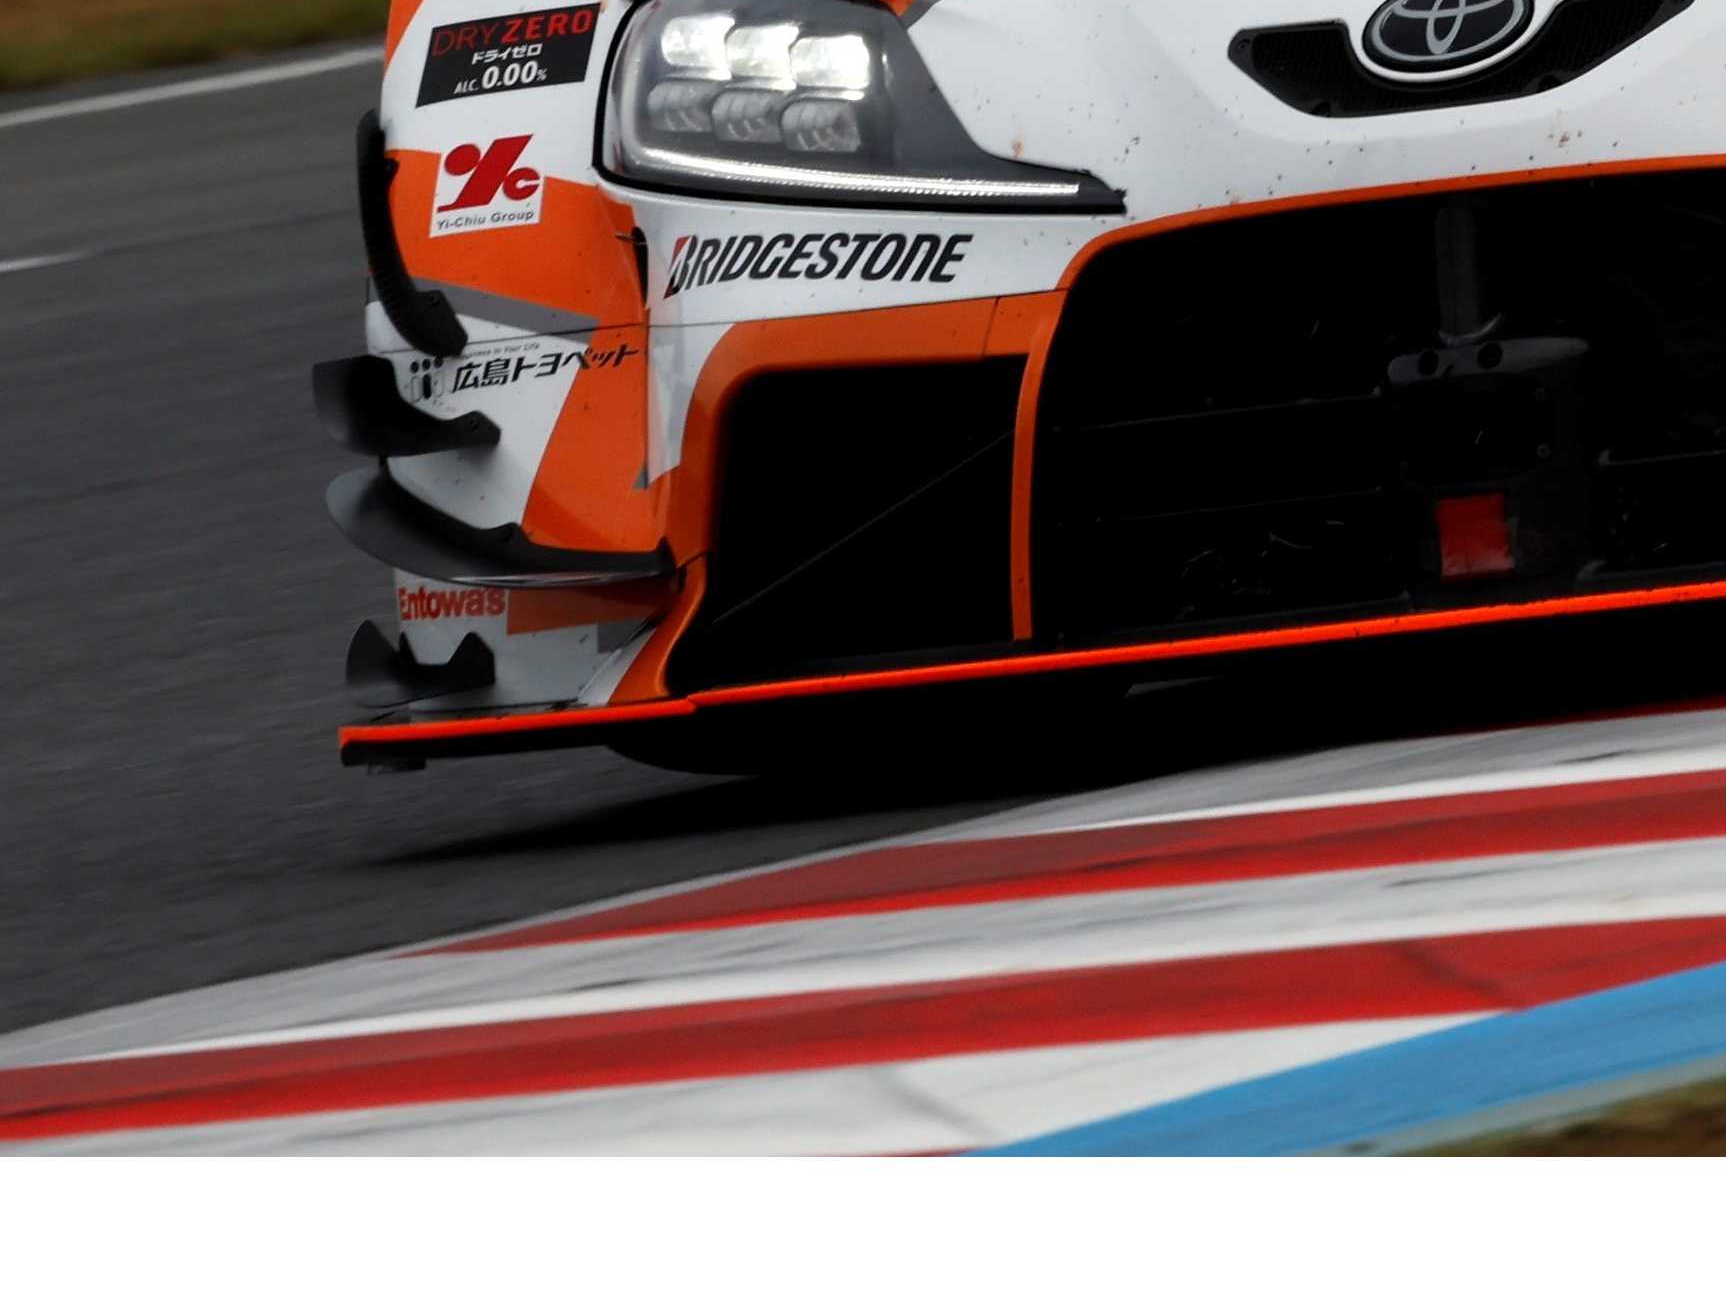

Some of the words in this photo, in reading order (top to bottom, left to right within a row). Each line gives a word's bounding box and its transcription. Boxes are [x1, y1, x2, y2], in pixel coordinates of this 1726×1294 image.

[471, 42, 543, 65] ドライゼロ
[454, 81, 479, 95] ALC.
[482, 61, 548, 89] 0.00%
[490, 210, 535, 224] Group
[663, 232, 974, 298] BRIDGESTONE
[452, 343, 640, 394] 広島トヨペット
